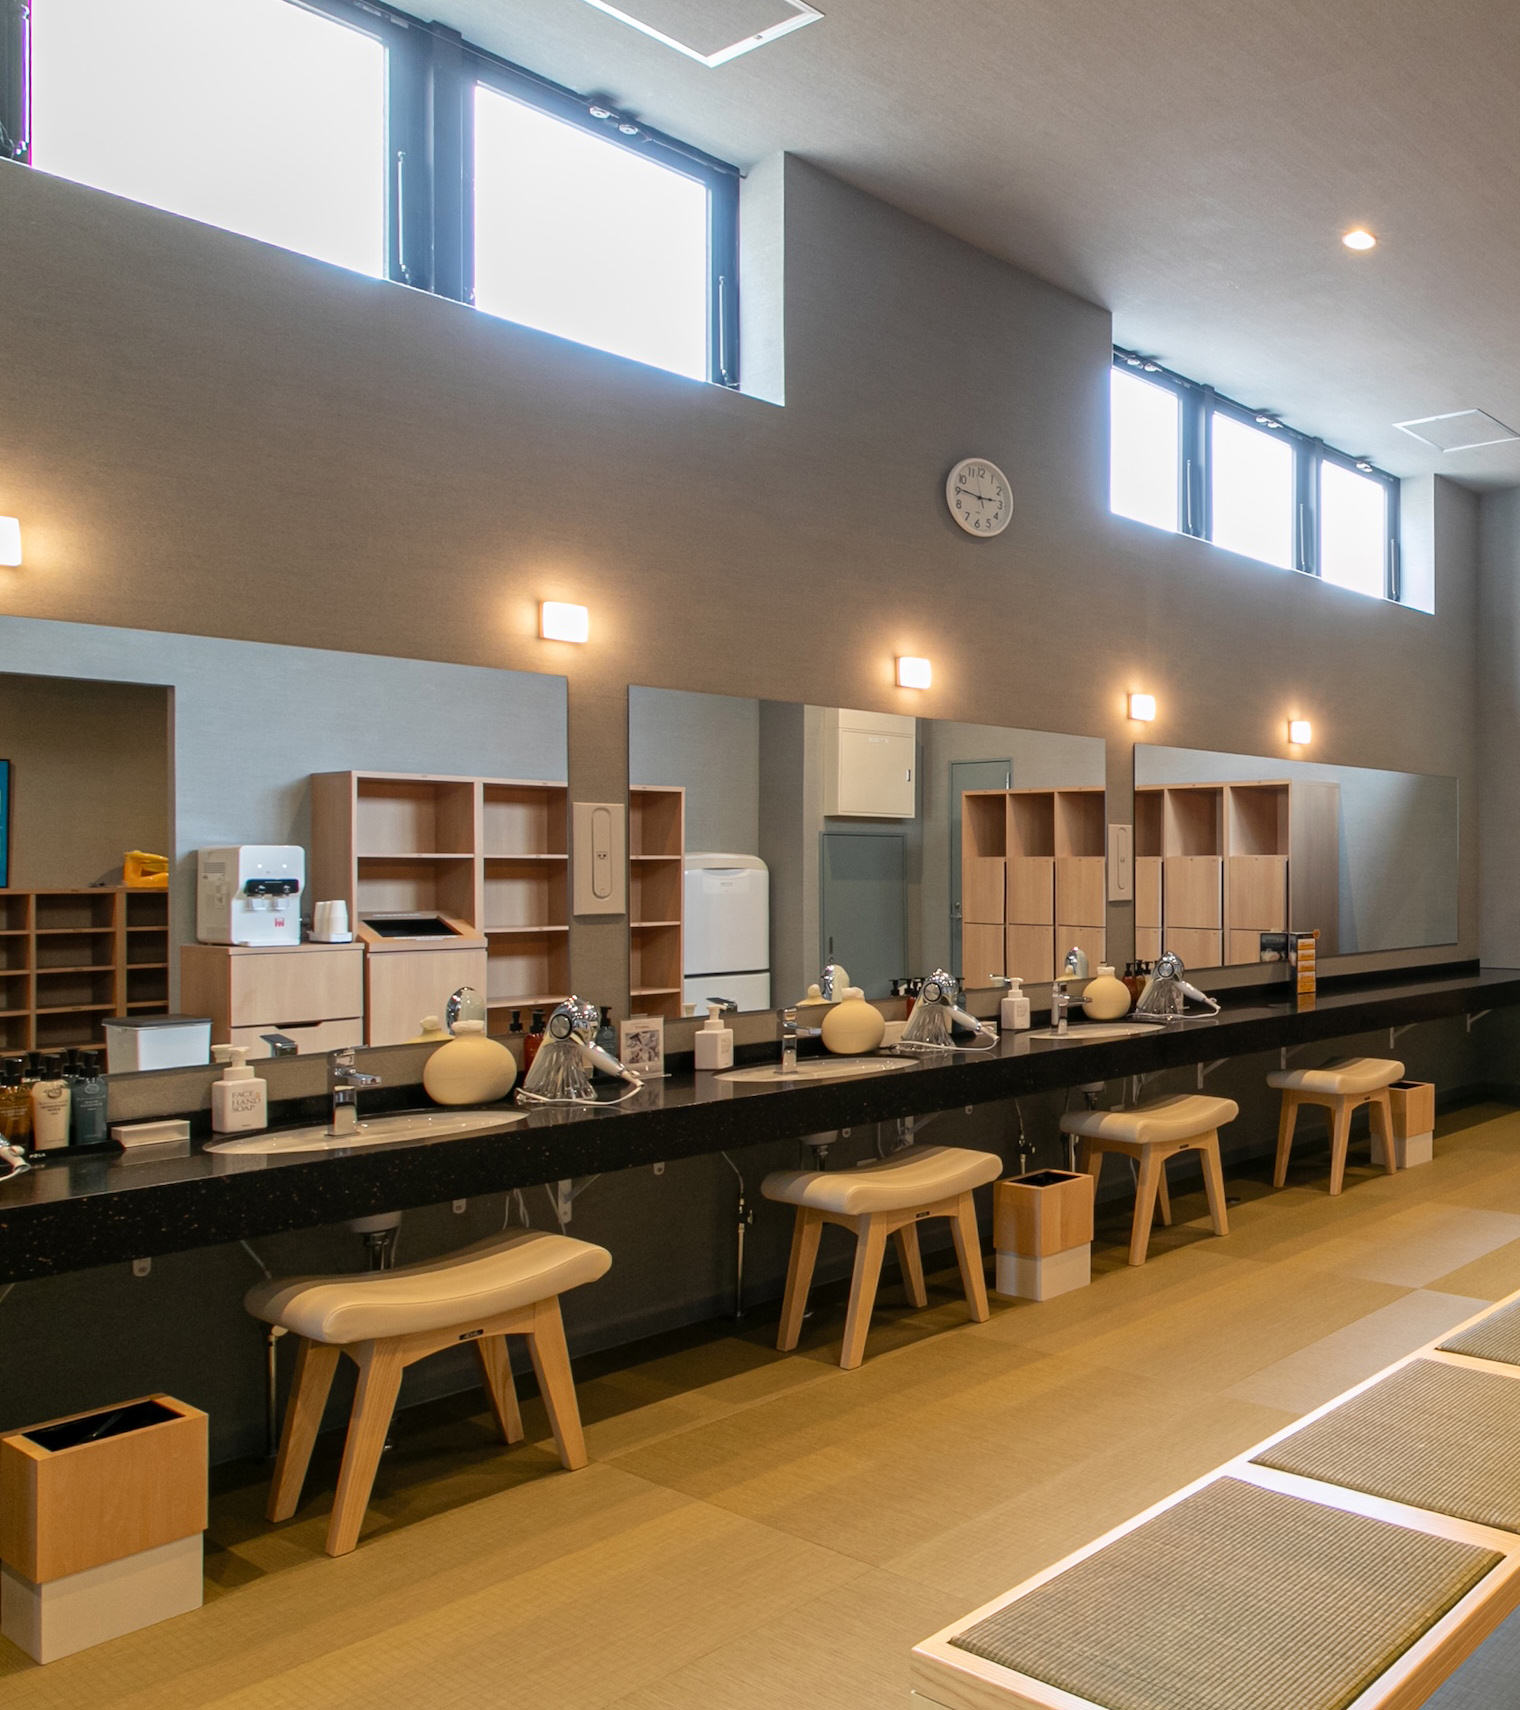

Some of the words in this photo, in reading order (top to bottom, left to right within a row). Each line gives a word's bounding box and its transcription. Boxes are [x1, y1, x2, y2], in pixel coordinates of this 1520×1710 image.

[968, 467, 975, 478] 11
[977, 468, 986, 479] 12
[959, 474, 967, 485] 10
[990, 475, 994, 484] 1
[955, 487, 961, 496] 9
[996, 486, 1002, 497] 2
[956, 500, 962, 509] 8
[997, 500, 1003, 510] 3
[964, 512, 970, 521] 7
[993, 512, 999, 520] 4
[974, 519, 980, 529] 6
[985, 518, 992, 528] 5
